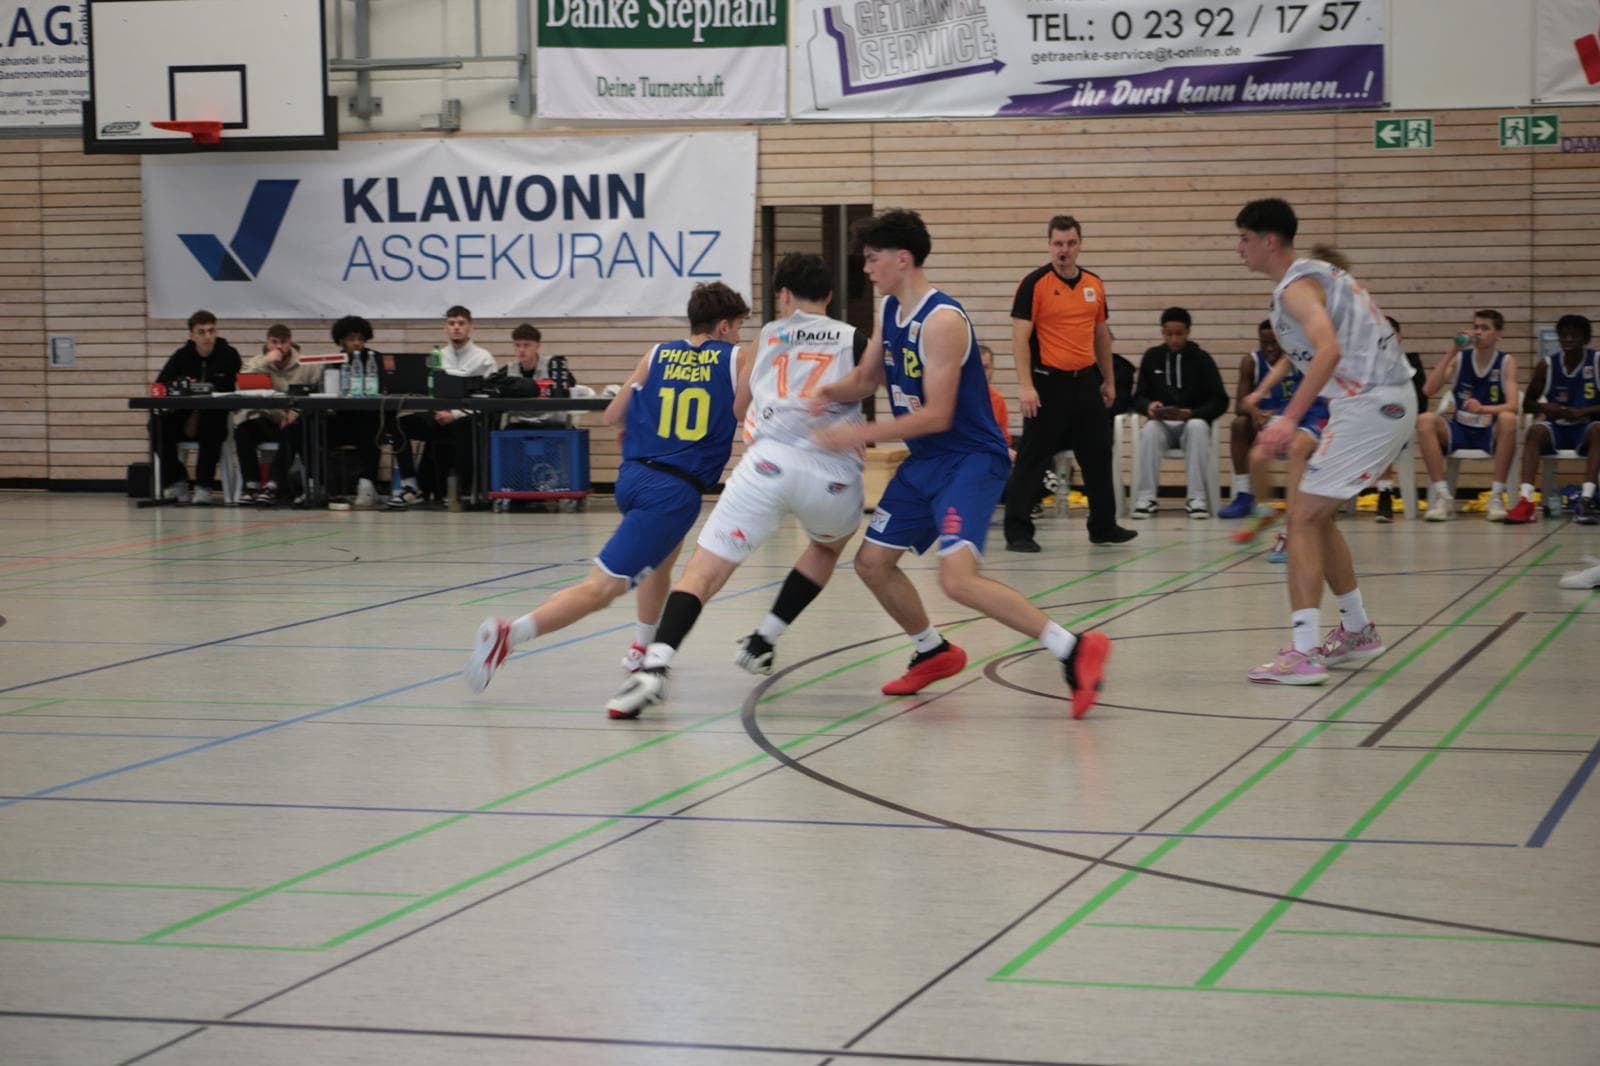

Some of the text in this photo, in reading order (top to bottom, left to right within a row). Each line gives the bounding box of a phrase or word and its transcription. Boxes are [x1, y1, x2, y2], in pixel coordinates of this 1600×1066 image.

[546, 0, 777, 43] Danke Stephan!
[1027, 1, 1361, 42] TEL.: 0 23 92 / 17 57
[860, 19, 993, 80] SERVICE
[1031, 46, 1241, 65] getraenke-service@t-online.de
[597, 74, 725, 97] Deine Turnerschaft
[1071, 70, 1374, 107] ihr Durst kann kommen...!
[343, 173, 646, 223] KLAWONN
[343, 230, 723, 281] ASSEKURANZ
[796, 330, 840, 342] PAULI
[658, 349, 721, 366] PHOENIX
[663, 364, 711, 382] HAGEN
[902, 348, 922, 378] 12
[772, 352, 834, 399] 17
[1584, 382, 1595, 399] 5
[1489, 384, 1499, 402] 9
[657, 387, 711, 441] 10
